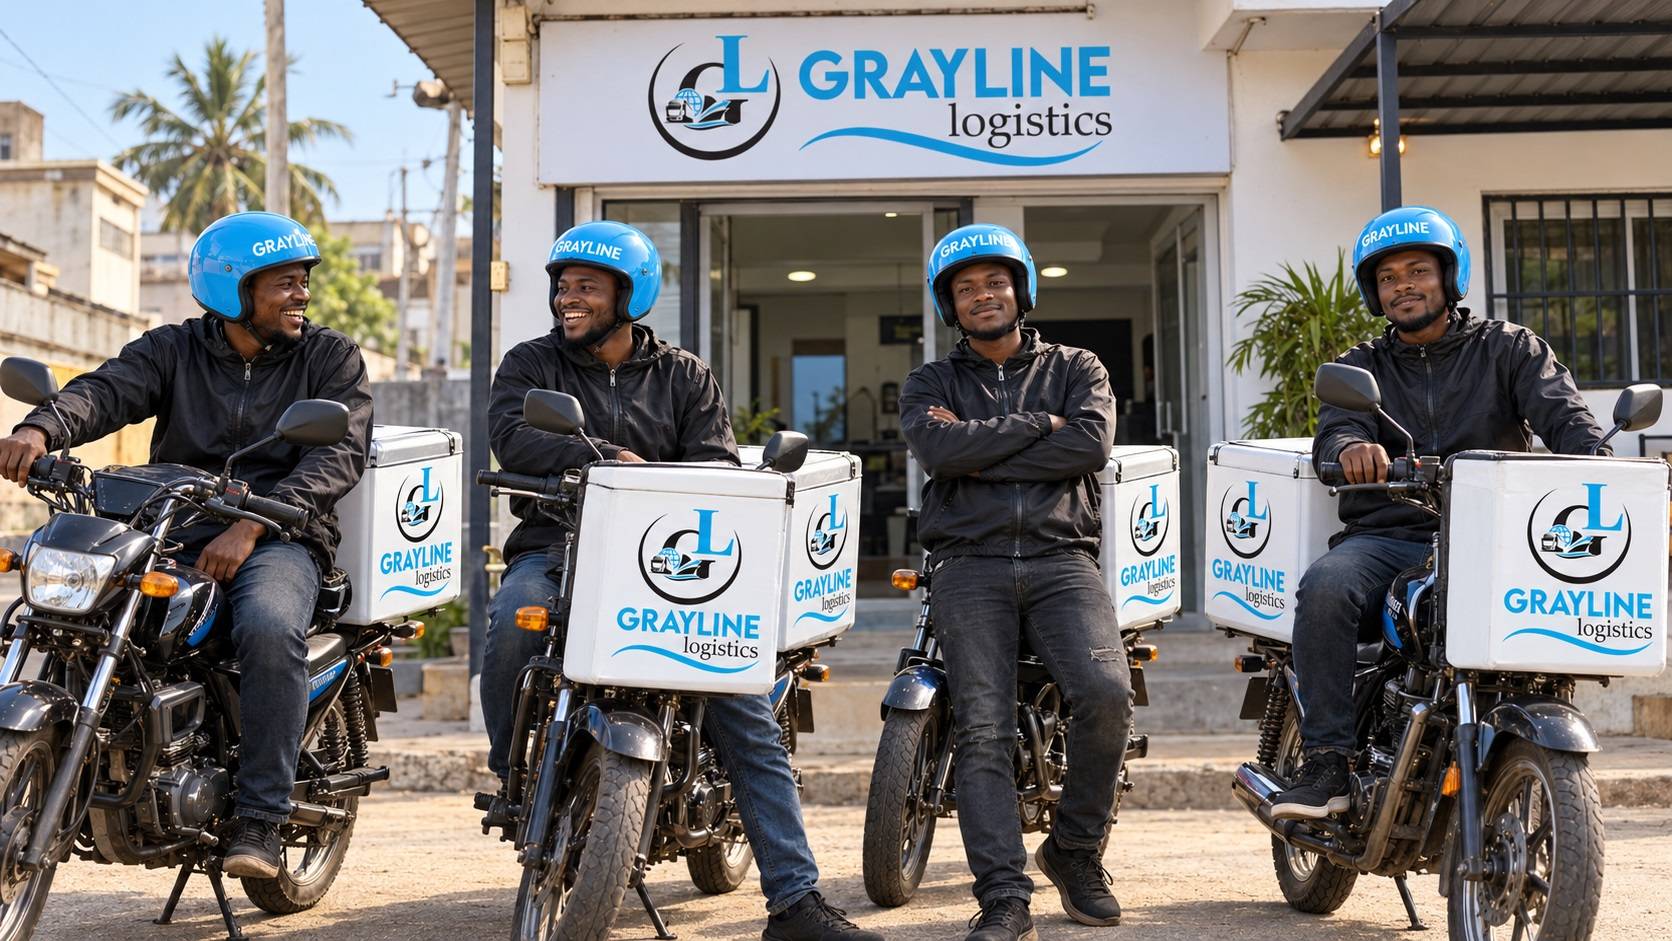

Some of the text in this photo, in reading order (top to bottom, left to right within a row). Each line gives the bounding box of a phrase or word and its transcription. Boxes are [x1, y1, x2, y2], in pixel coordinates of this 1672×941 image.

[798, 45, 1112, 101] GRAYLINE
[947, 102, 1113, 149] logistics
[940, 233, 1012, 258] GRAYLINE
[1361, 221, 1430, 247] GRAYLINE
[555, 240, 623, 261] GRAYLINE
[380, 541, 453, 575] GRAYLINE
[1120, 554, 1176, 587] GRAYLINE
[415, 566, 452, 588] logistics
[794, 568, 852, 602] GRAYLINE
[1147, 577, 1176, 597] logistics
[1211, 558, 1286, 593] GRAYLINE
[821, 591, 852, 613] logistics
[1245, 586, 1285, 609] logistics
[1503, 588, 1653, 620] GRAYLINE
[616, 606, 761, 640] GRAYLINE
[1577, 618, 1653, 642] logistics
[683, 635, 760, 661] logistics
